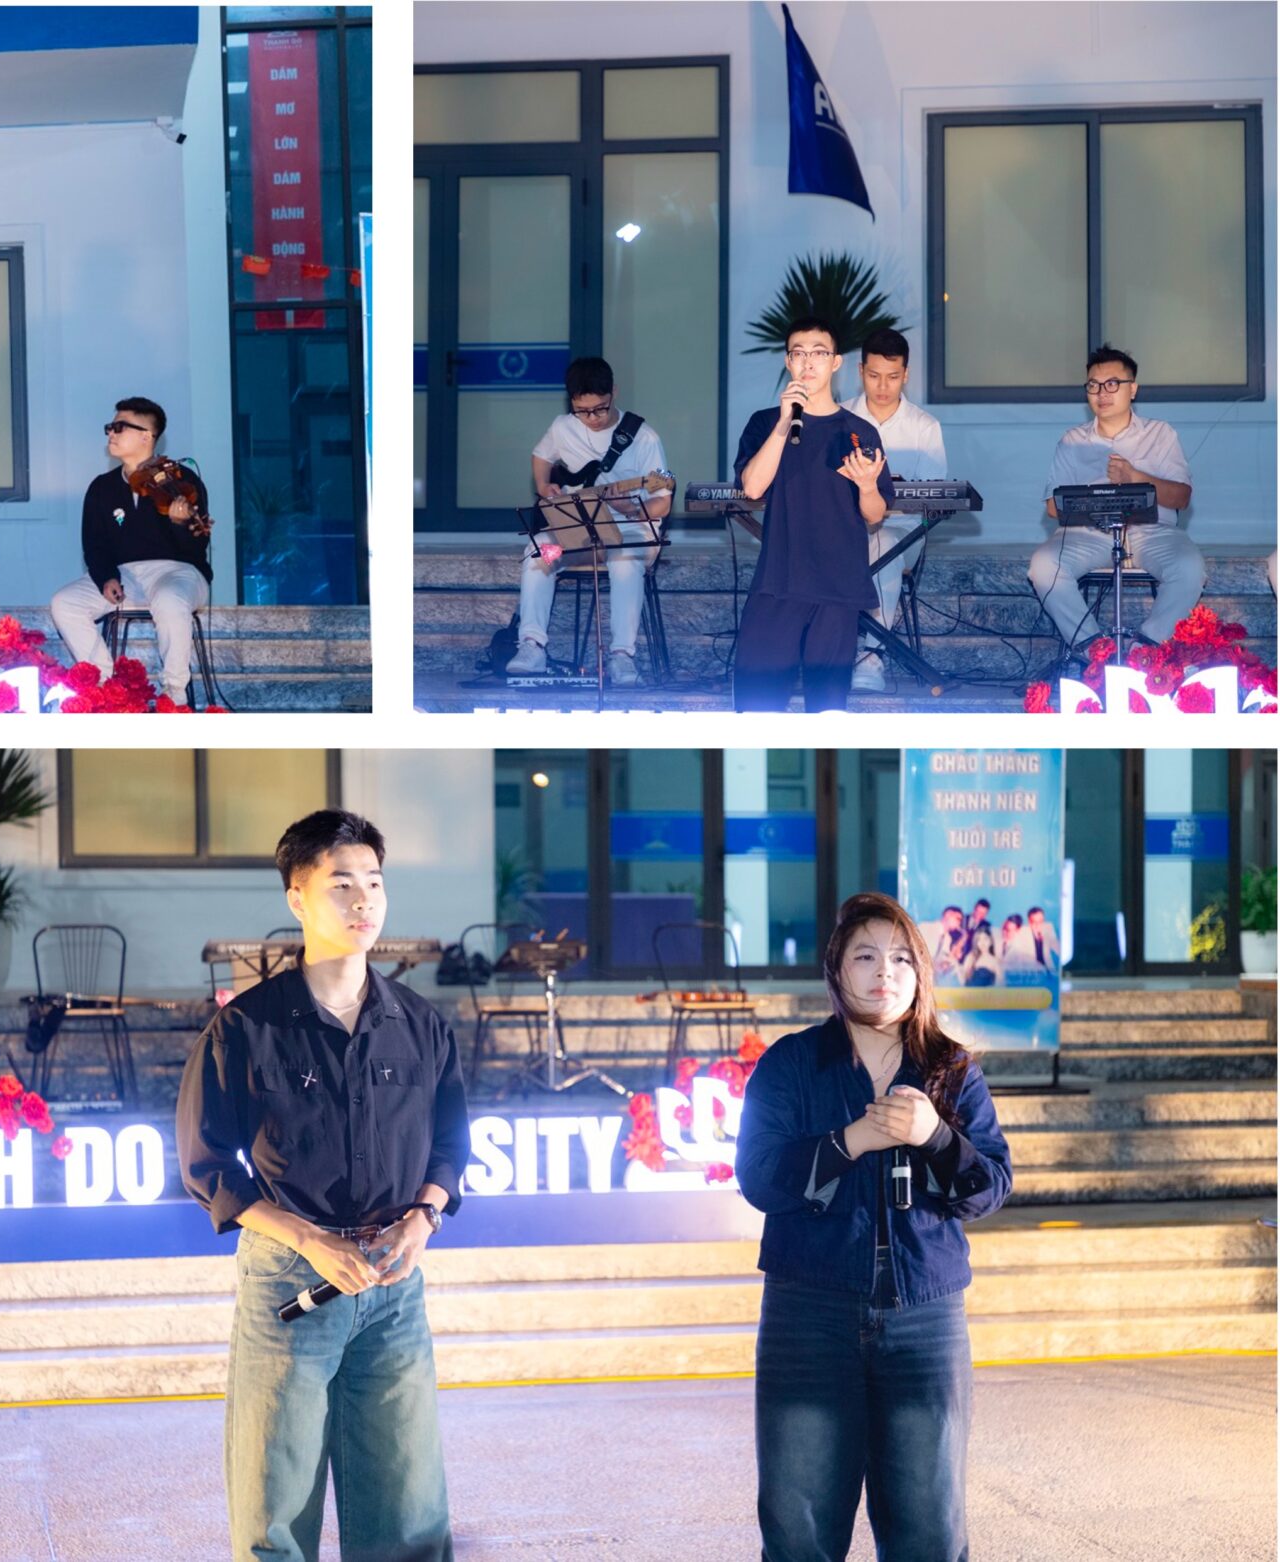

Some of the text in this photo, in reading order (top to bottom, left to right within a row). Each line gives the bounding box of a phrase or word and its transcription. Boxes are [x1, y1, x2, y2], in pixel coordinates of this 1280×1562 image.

[711, 488, 746, 499] YAMAH
[894, 488, 942, 497] TAGE
[934, 788, 1037, 811] THANH NIÊN
[64, 1123, 166, 1207] DO
